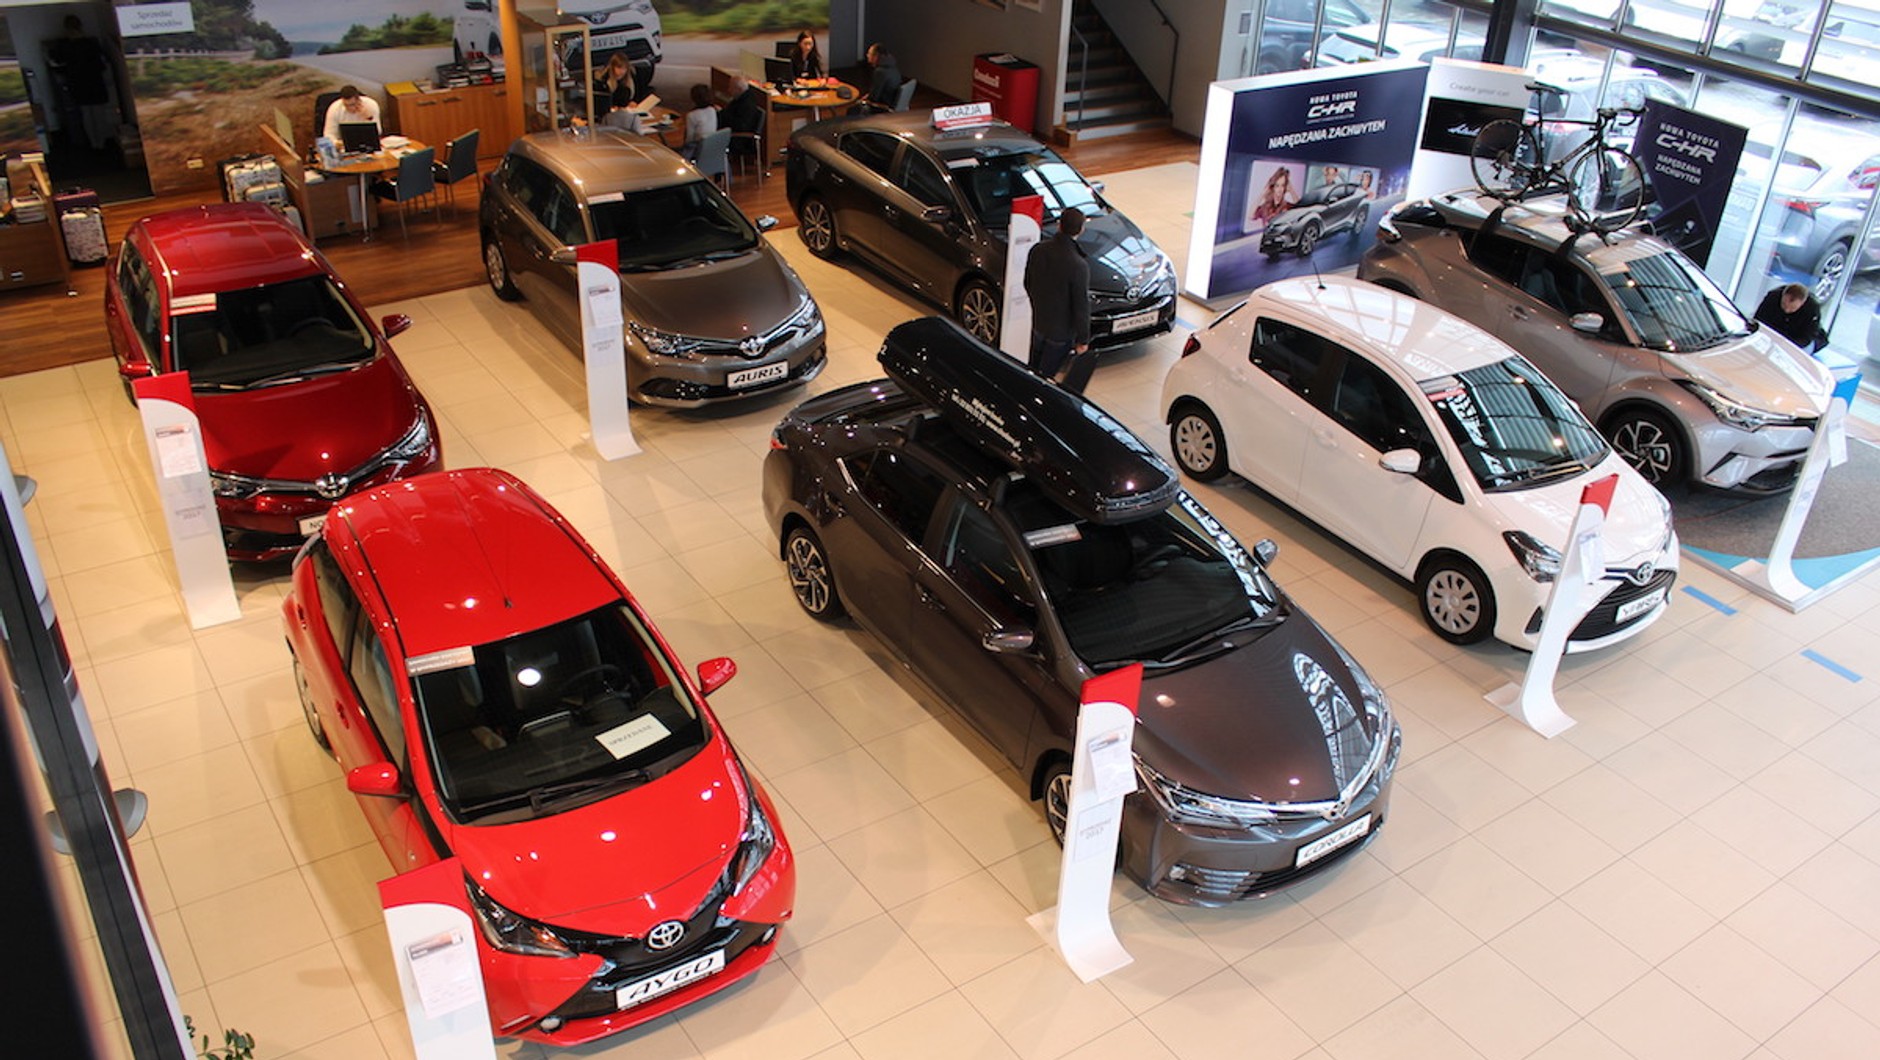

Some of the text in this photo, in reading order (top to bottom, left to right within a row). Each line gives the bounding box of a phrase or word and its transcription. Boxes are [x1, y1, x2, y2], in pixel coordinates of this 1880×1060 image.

[1309, 90, 1358, 105] NOWA TOYOTA
[1450, 82, 1476, 92] Create
[1477, 88, 1495, 97] your
[943, 104, 982, 119] OKAZJA
[1307, 100, 1357, 119] C-HR
[1268, 128, 1327, 150] NAPĘDZANA
[1328, 119, 1386, 140] ZACHWYTEM
[1660, 122, 1720, 149] NOWA TOYOTA
[1655, 132, 1717, 164] C-HR
[733, 364, 784, 384] AURIS
[1303, 821, 1365, 858] COROLLA
[629, 956, 714, 1000] AYGO
